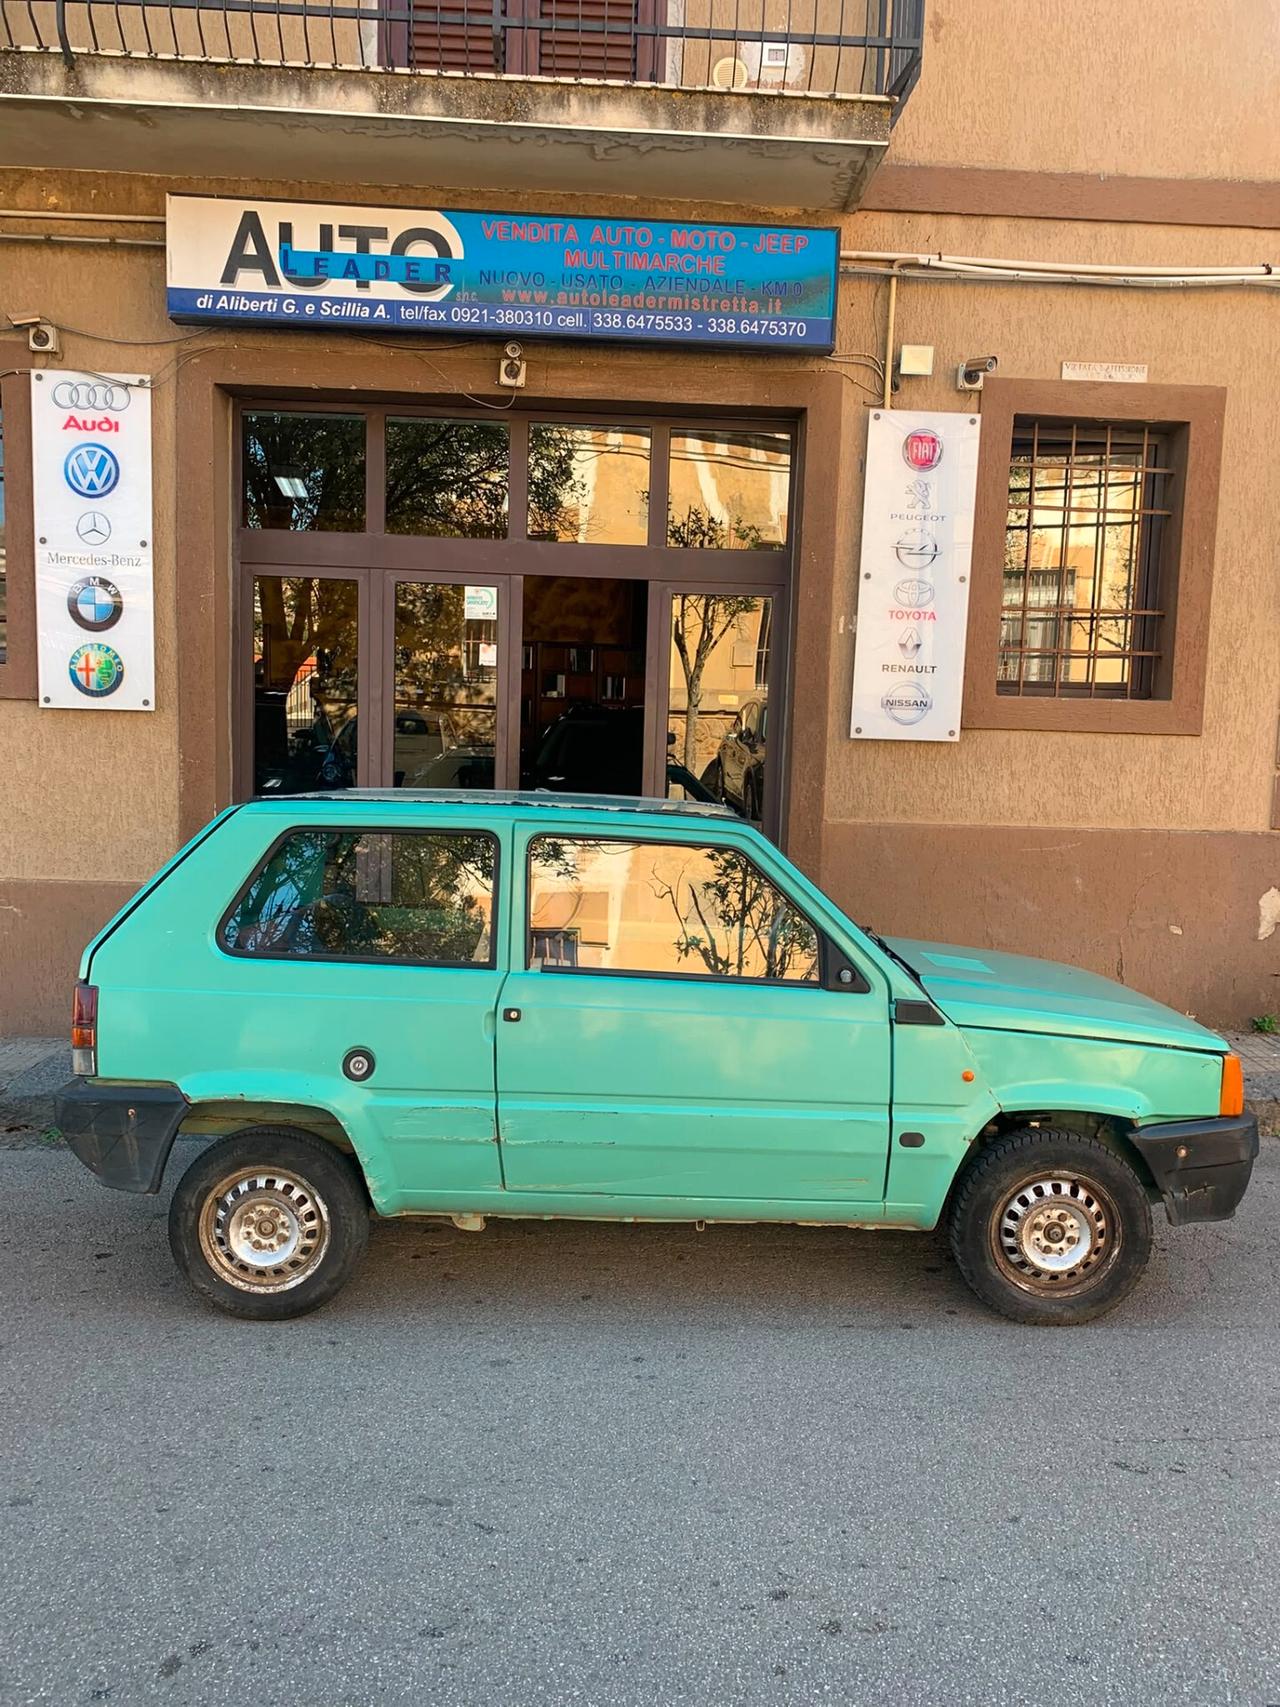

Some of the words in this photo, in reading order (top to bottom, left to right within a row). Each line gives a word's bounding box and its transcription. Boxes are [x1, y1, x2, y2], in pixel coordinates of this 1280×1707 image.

[482, 220, 579, 244] VENDITA
[590, 225, 653, 248] AUTO
[671, 229, 736, 251] MOTO
[753, 233, 808, 255] JEEP
[220, 210, 453, 294] AUTO
[564, 249, 726, 276] MULTIMARCHE
[282, 249, 451, 283] LEADER
[479, 270, 545, 287] NUOVO
[561, 273, 623, 290] USATO
[644, 276, 746, 294] AZIENDALE
[761, 280, 788, 297] KM
[793, 282, 803, 297] 0
[196, 294, 212, 309] di
[216, 295, 278, 312] Aliberti
[282, 299, 300, 314] G.
[305, 304, 315, 315] e
[320, 301, 369, 318] Scillia
[373, 304, 391, 319] A.
[502, 289, 782, 315] www.autoleadermistretta.it
[400, 305, 447, 321] tel/fax
[451, 307, 552, 326] 0921-380310
[557, 314, 587, 328] cell.
[593, 313, 693, 332] 338.6475533
[707, 318, 806, 337] 338.6475370
[62, 415, 120, 433] Audi
[912, 441, 935, 461] FIAT
[890, 513, 946, 522] PEUGEOT
[47, 551, 142, 568] Mercedes-Benz
[71, 577, 119, 595] BMW
[888, 609, 937, 622] TOYOTA
[881, 664, 938, 674] RENAULT
[885, 698, 928, 708] NISSAN
